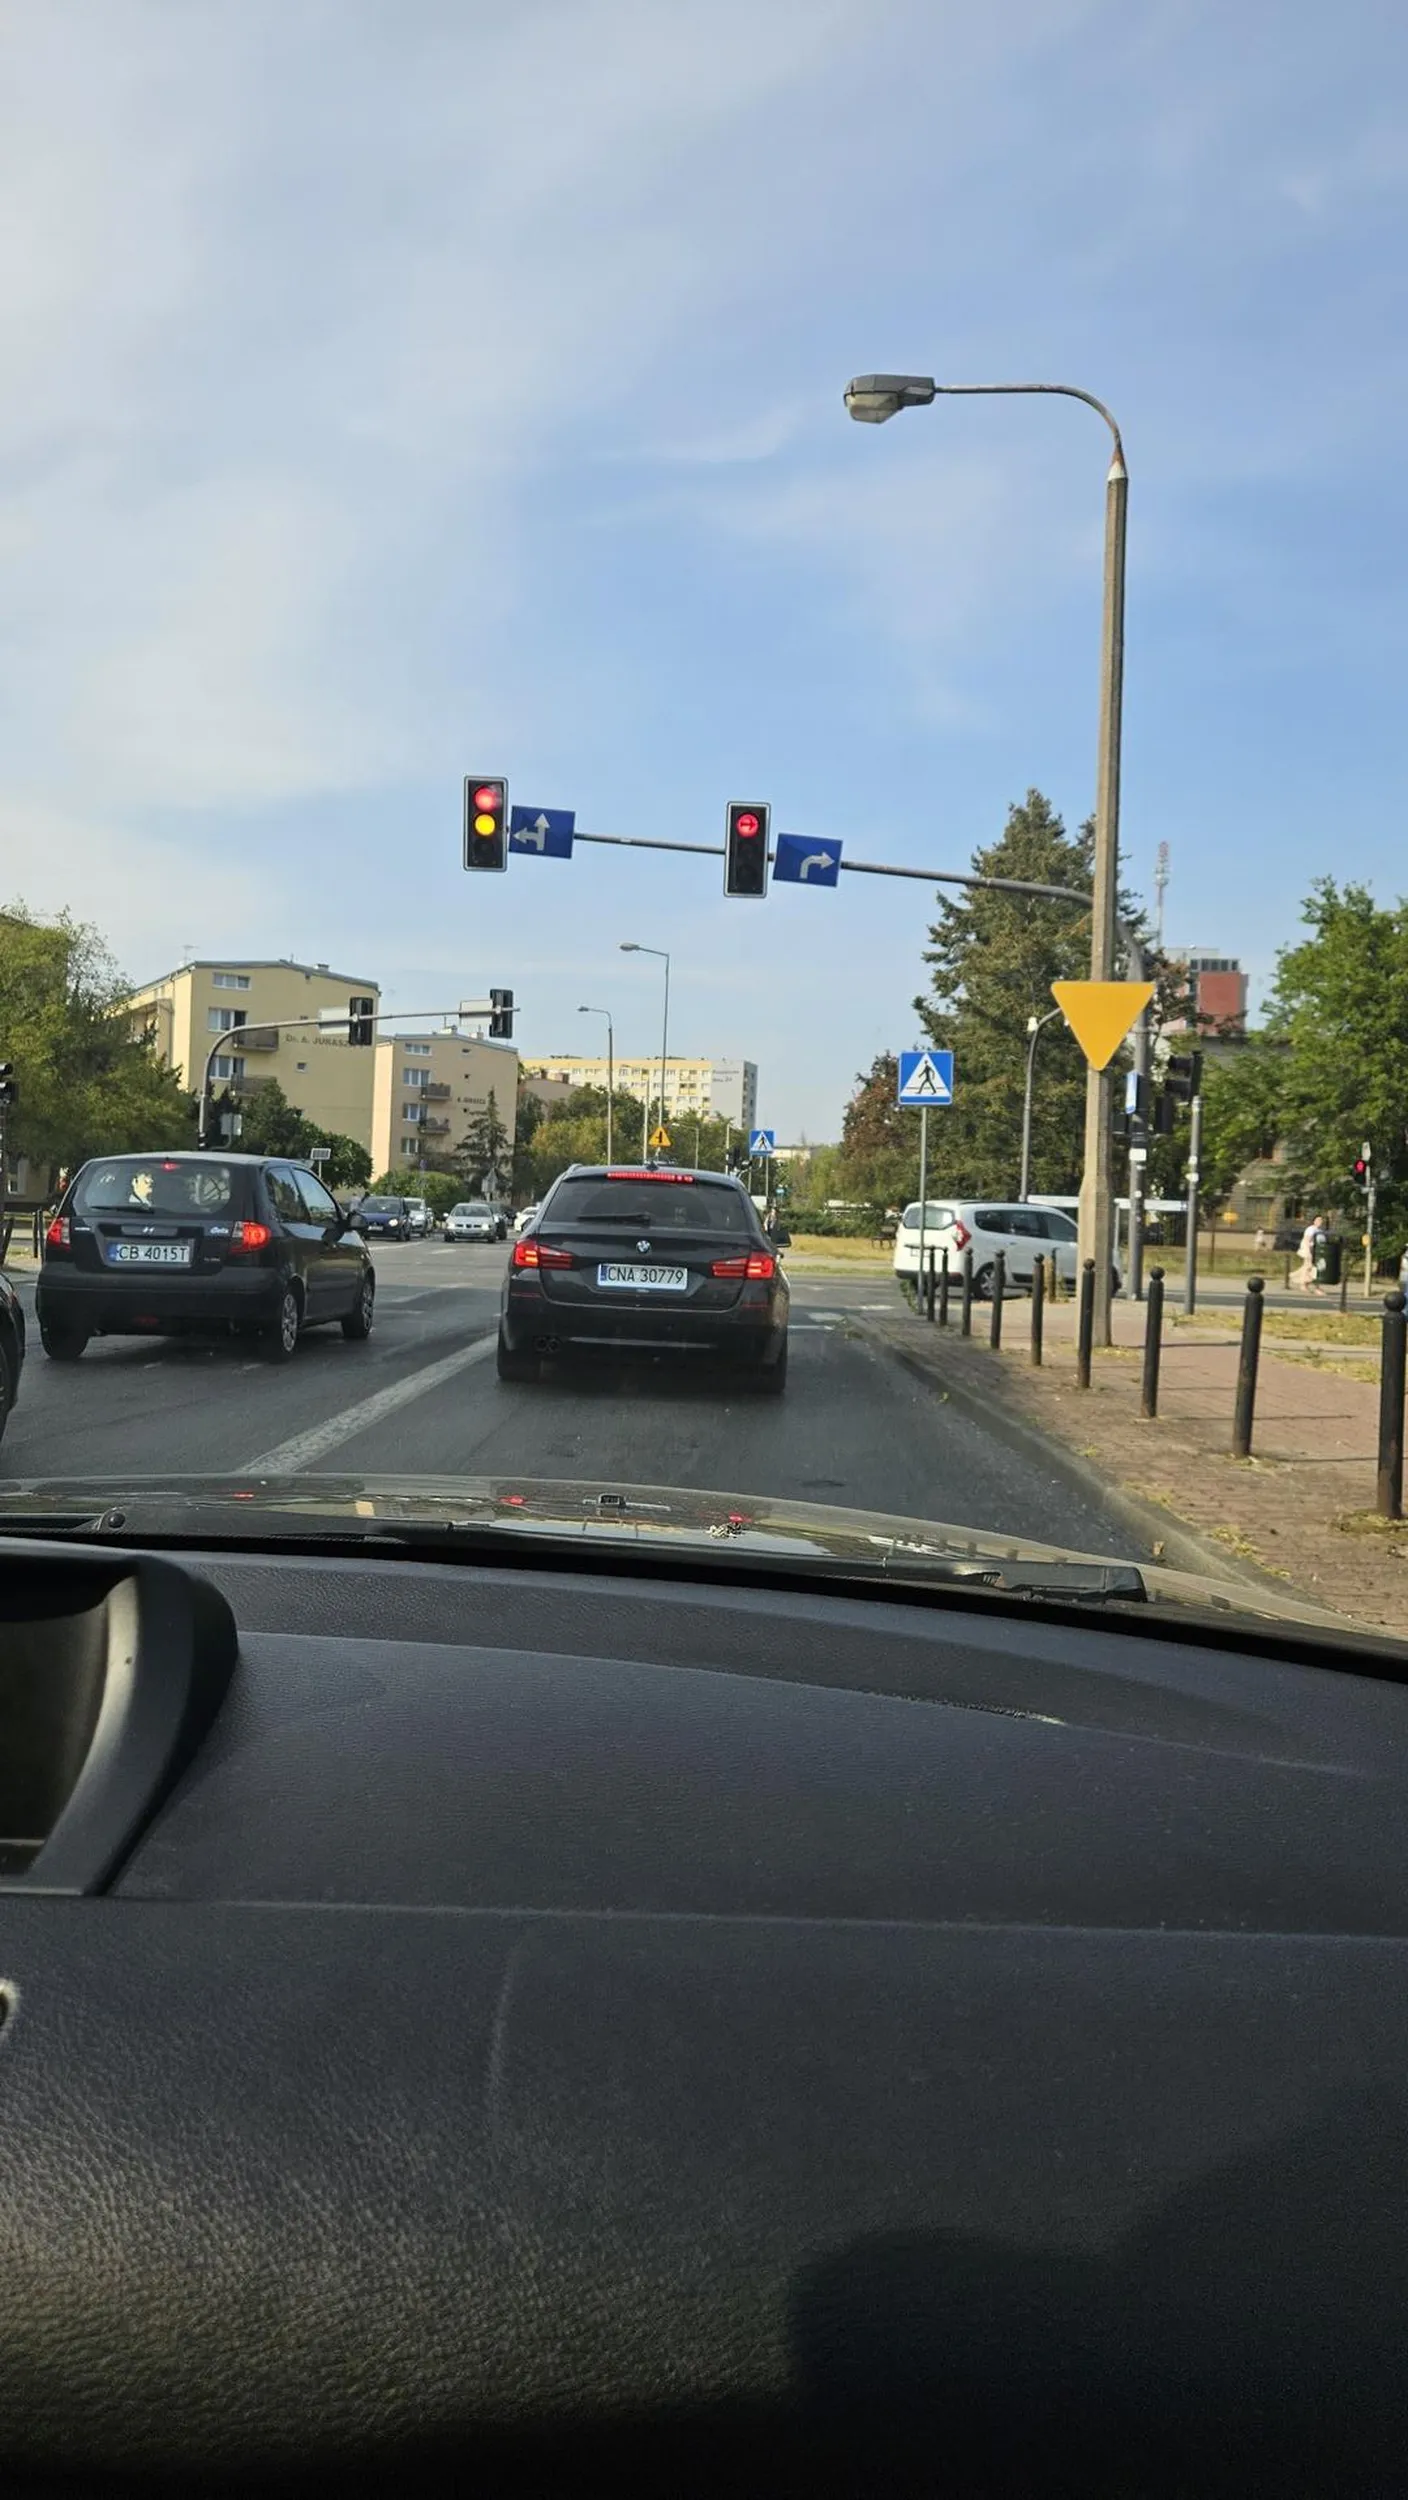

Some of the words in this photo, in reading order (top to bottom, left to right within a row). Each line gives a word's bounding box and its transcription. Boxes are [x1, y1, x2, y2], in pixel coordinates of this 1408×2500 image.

[312, 1037, 349, 1047] JURASZ
[119, 1246, 140, 1260] CB
[144, 1246, 188, 1261] 4015T
[608, 1266, 635, 1282] CNA
[640, 1267, 684, 1284] 30779
